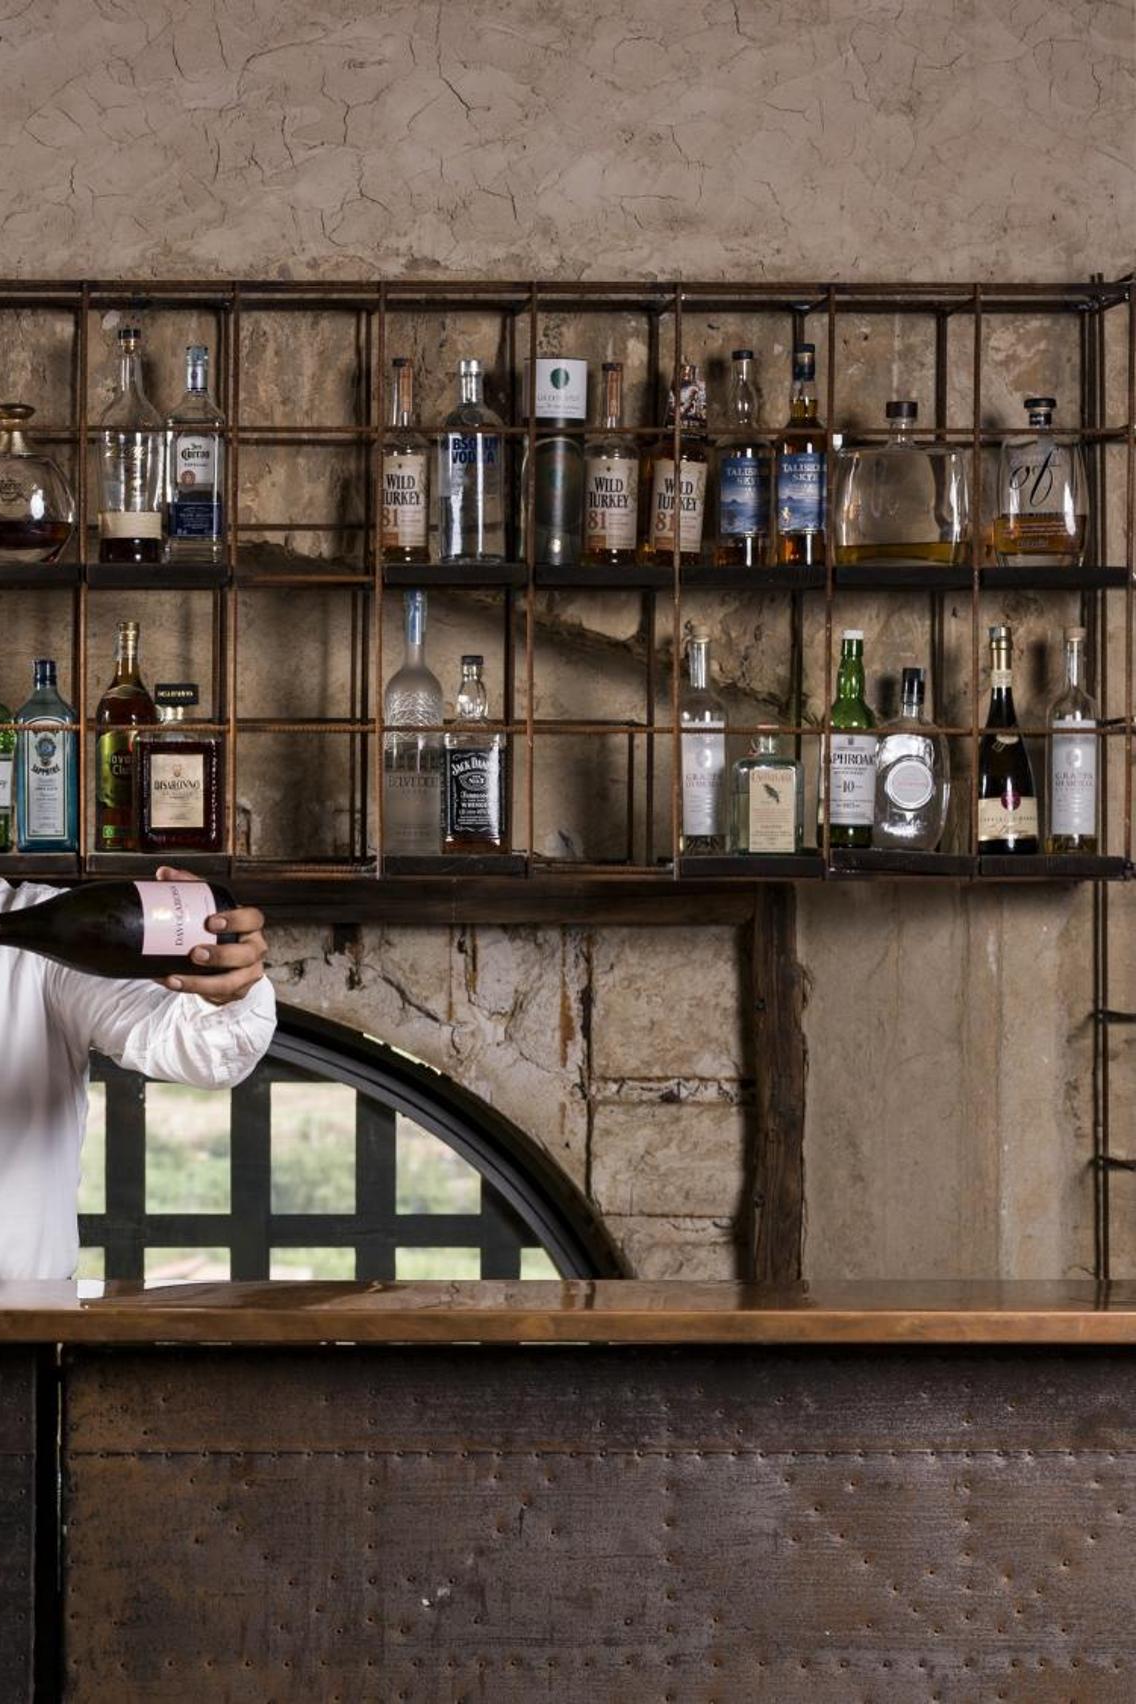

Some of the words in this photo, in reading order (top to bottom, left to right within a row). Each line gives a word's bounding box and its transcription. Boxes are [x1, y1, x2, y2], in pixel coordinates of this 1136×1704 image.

[452, 450, 495, 464] VODA
[385, 474, 416, 490] WILD
[594, 477, 623, 493] WILD
[589, 491, 630, 508] TURKEY
[587, 511, 606, 530] 81
